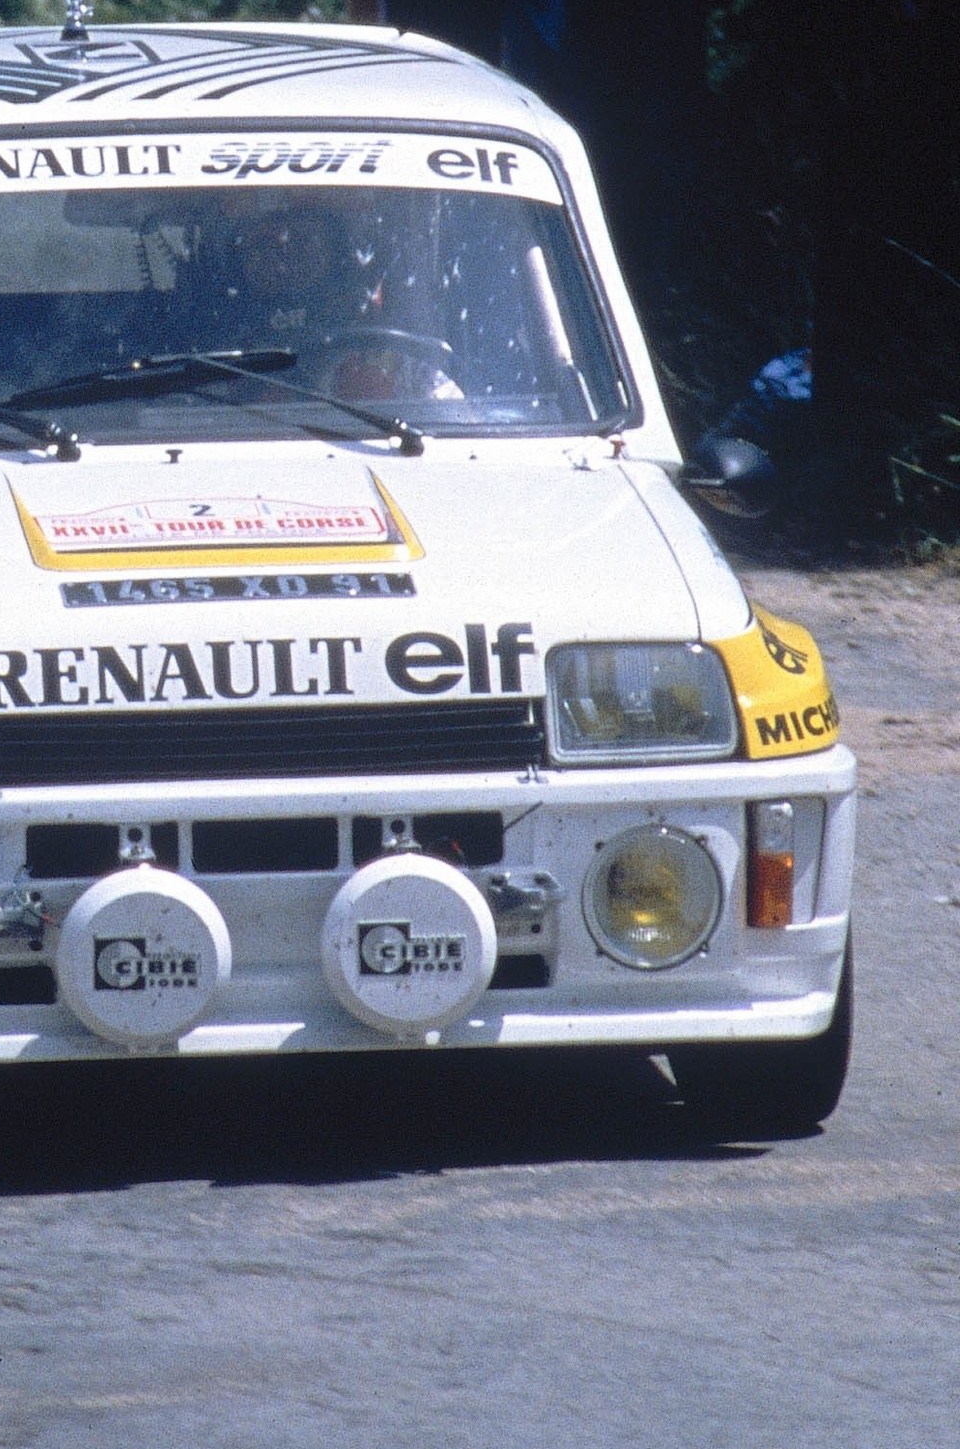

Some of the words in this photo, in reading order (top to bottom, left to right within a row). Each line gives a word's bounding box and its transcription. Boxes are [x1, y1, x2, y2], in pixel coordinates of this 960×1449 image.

[200, 140, 392, 180] sport
[426, 148, 519, 185] elf
[153, 519, 226, 534] TOUR
[233, 518, 267, 530] DE
[276, 516, 368, 530] CORSE
[188, 503, 216, 517] 2
[241, 575, 308, 598] XD
[384, 622, 536, 695] elf
[754, 694, 840, 746] MICH
